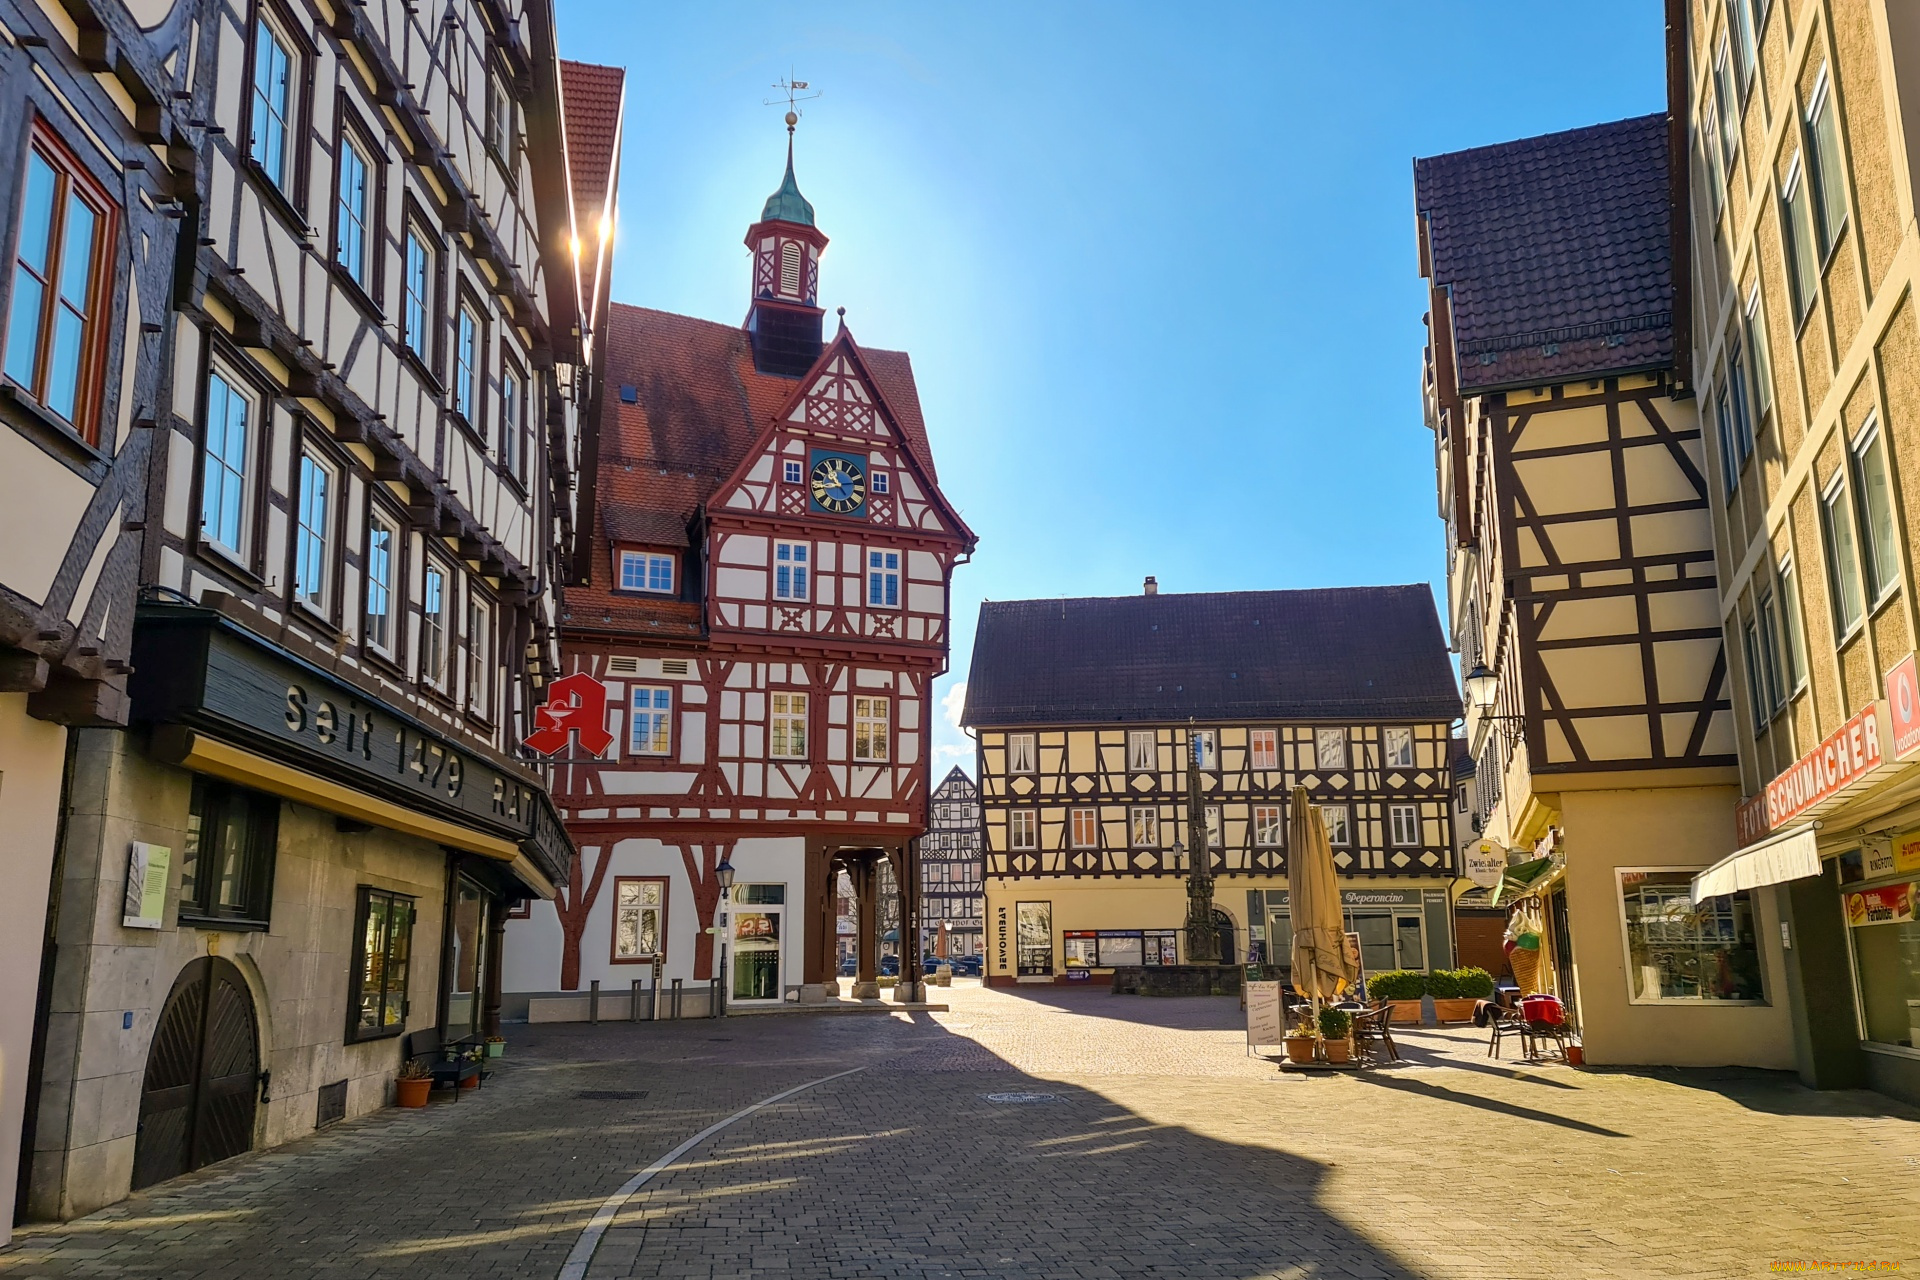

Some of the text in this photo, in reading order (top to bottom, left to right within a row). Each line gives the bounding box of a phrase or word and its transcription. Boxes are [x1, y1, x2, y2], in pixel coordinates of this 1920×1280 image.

[395, 727, 465, 798] 1479
[1743, 796, 1770, 840] FOTO
[1769, 713, 1880, 823] SCHUMACHER
[1468, 858, 1504, 868] Zwiealter
[1345, 892, 1404, 904] Peperoncino
[998, 906, 1007, 970] BEWOHNBAR
